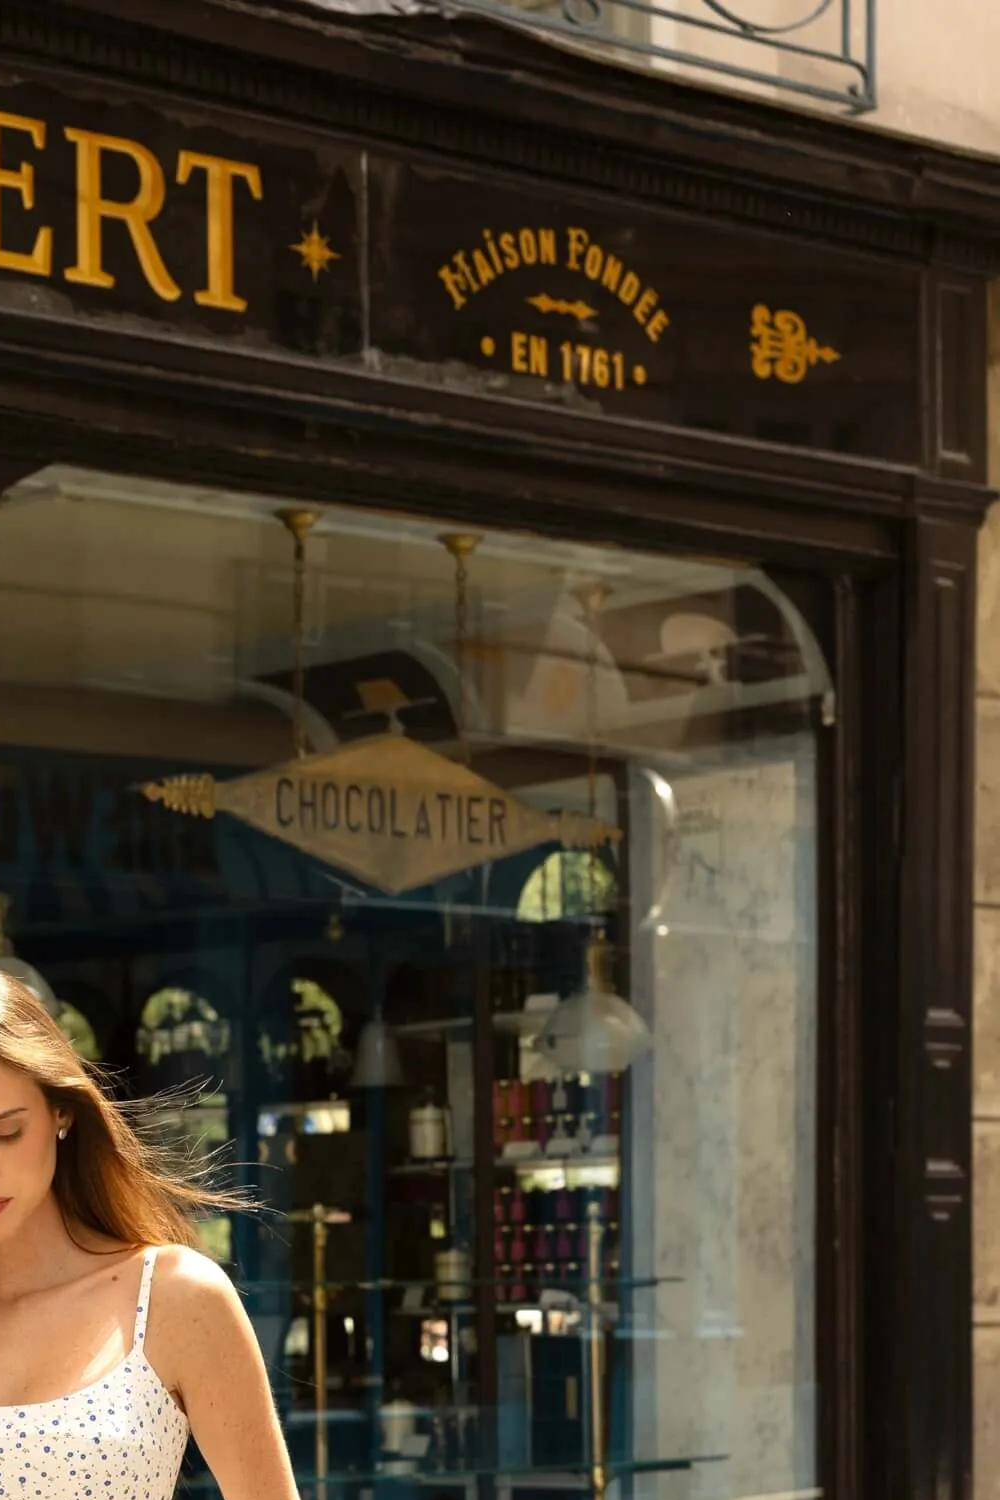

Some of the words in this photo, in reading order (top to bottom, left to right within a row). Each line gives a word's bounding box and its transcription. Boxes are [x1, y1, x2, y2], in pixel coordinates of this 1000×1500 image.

[511, 331, 548, 377] EN
[560, 341, 625, 391] 1761
[275, 777, 507, 845] CHOCOLATIER
